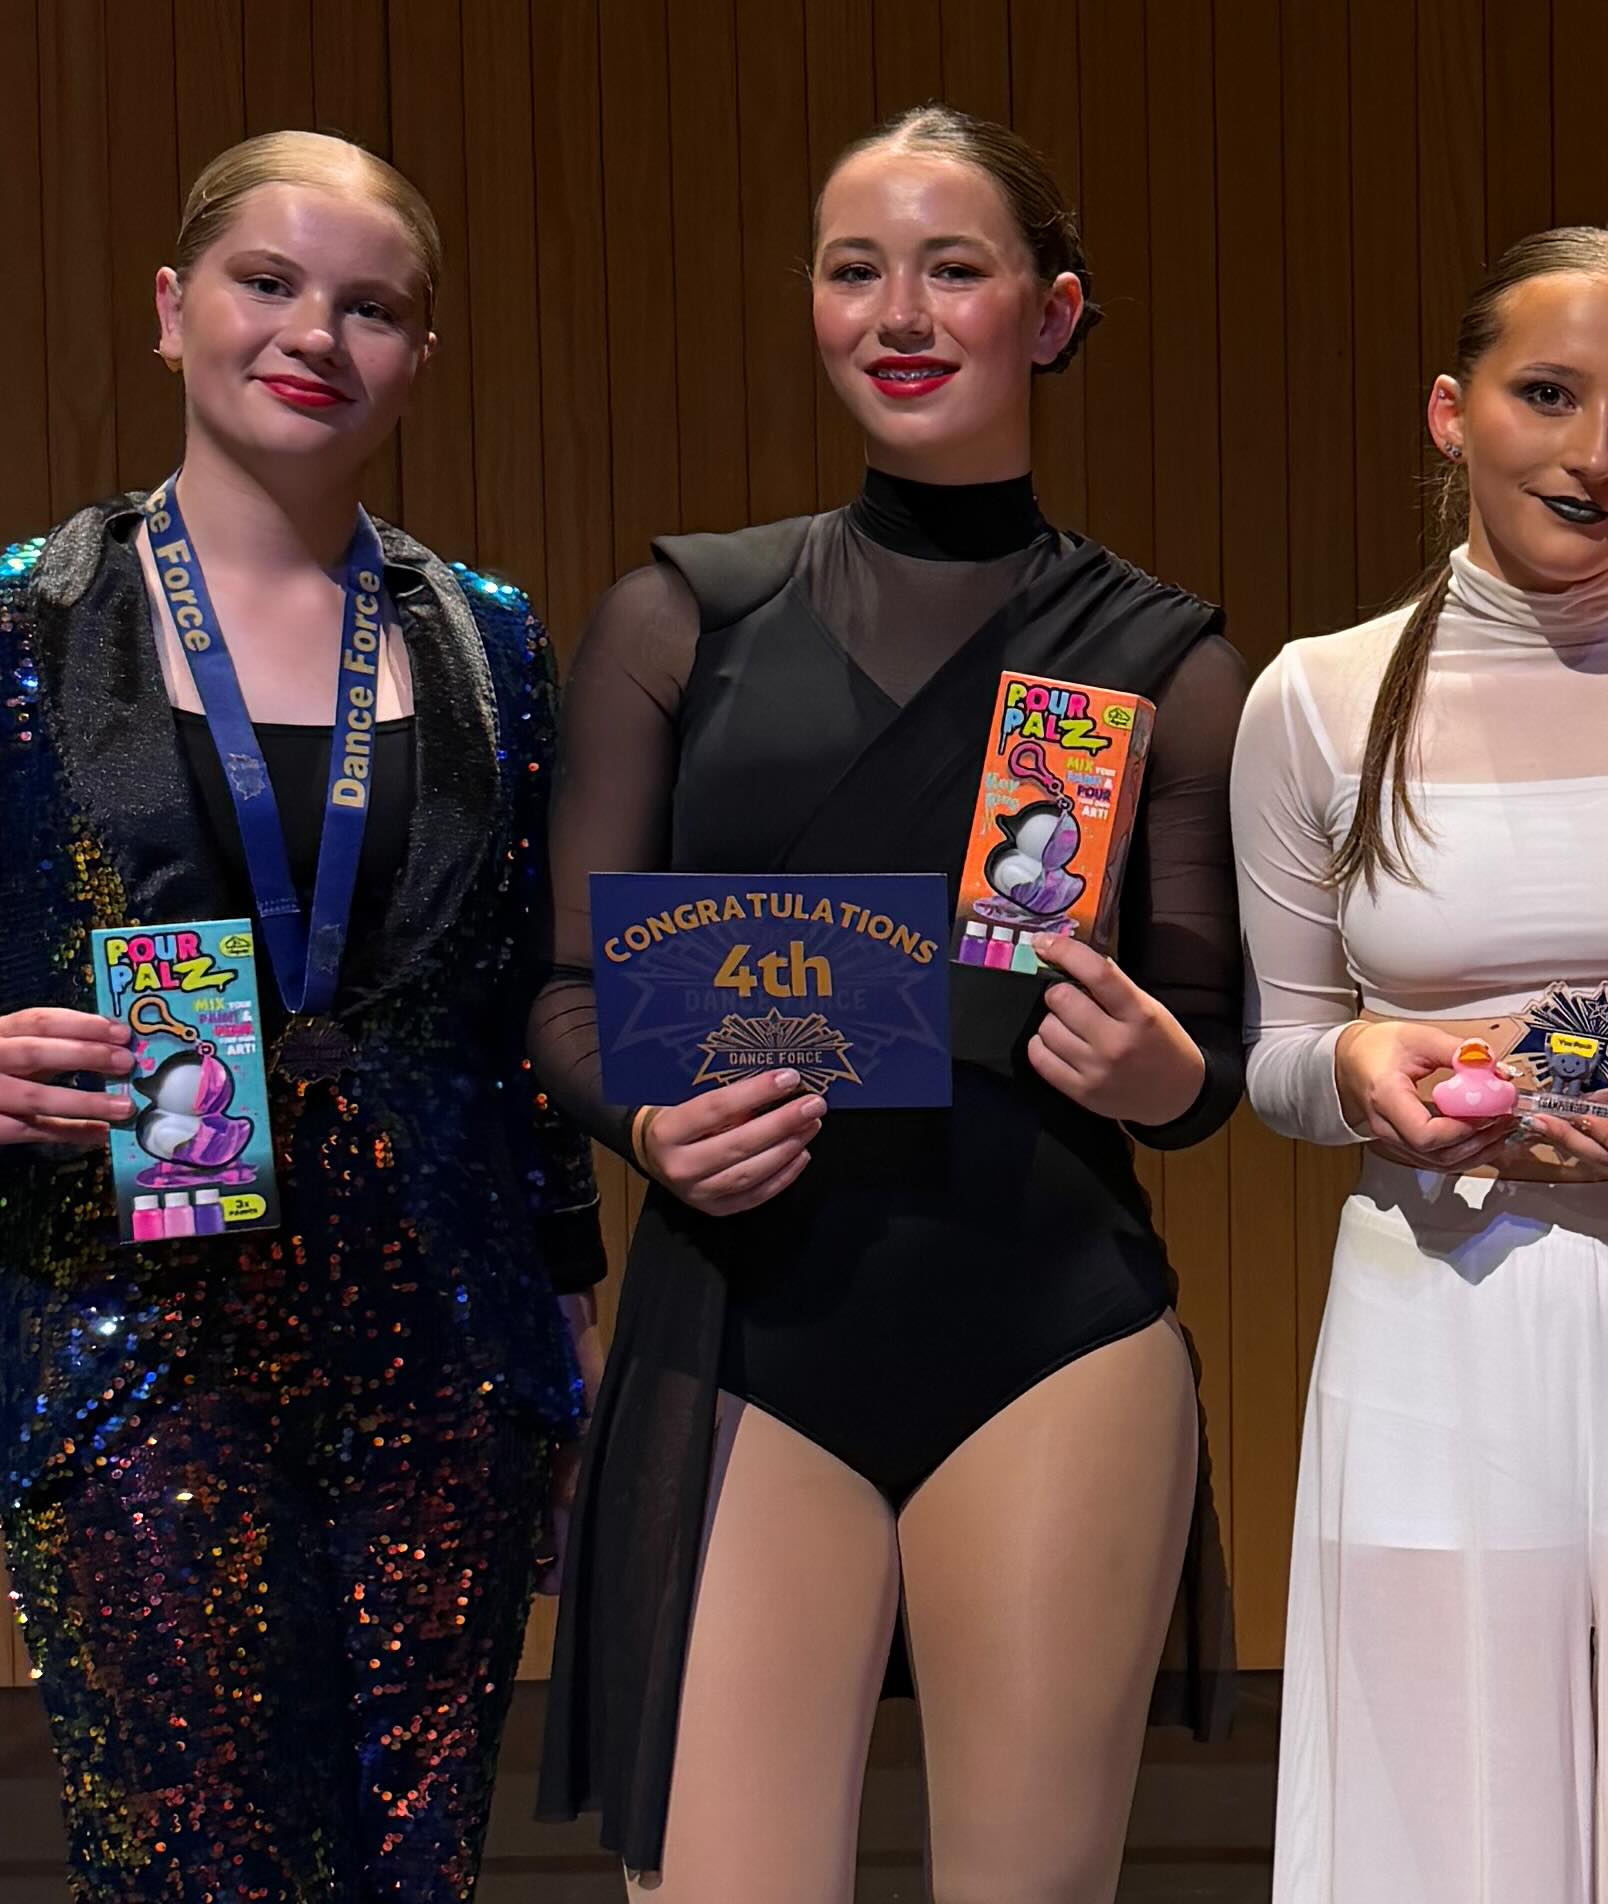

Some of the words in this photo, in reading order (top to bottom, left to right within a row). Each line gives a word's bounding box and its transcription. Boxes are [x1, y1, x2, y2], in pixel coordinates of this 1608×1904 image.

[155, 539, 211, 652] Force
[344, 570, 381, 675] Force
[1005, 681, 1089, 720] POUR
[332, 686, 374, 809] Dance
[1001, 707, 1111, 751] PALZ
[1077, 784, 1111, 802] POUR
[106, 932, 200, 965] POUR
[603, 893, 938, 964] CONGRATULATIONS
[109, 956, 239, 995] PALZ
[713, 941, 833, 998] 4th
[729, 1051, 774, 1065] DANCE
[779, 1050, 823, 1064] FORCE
